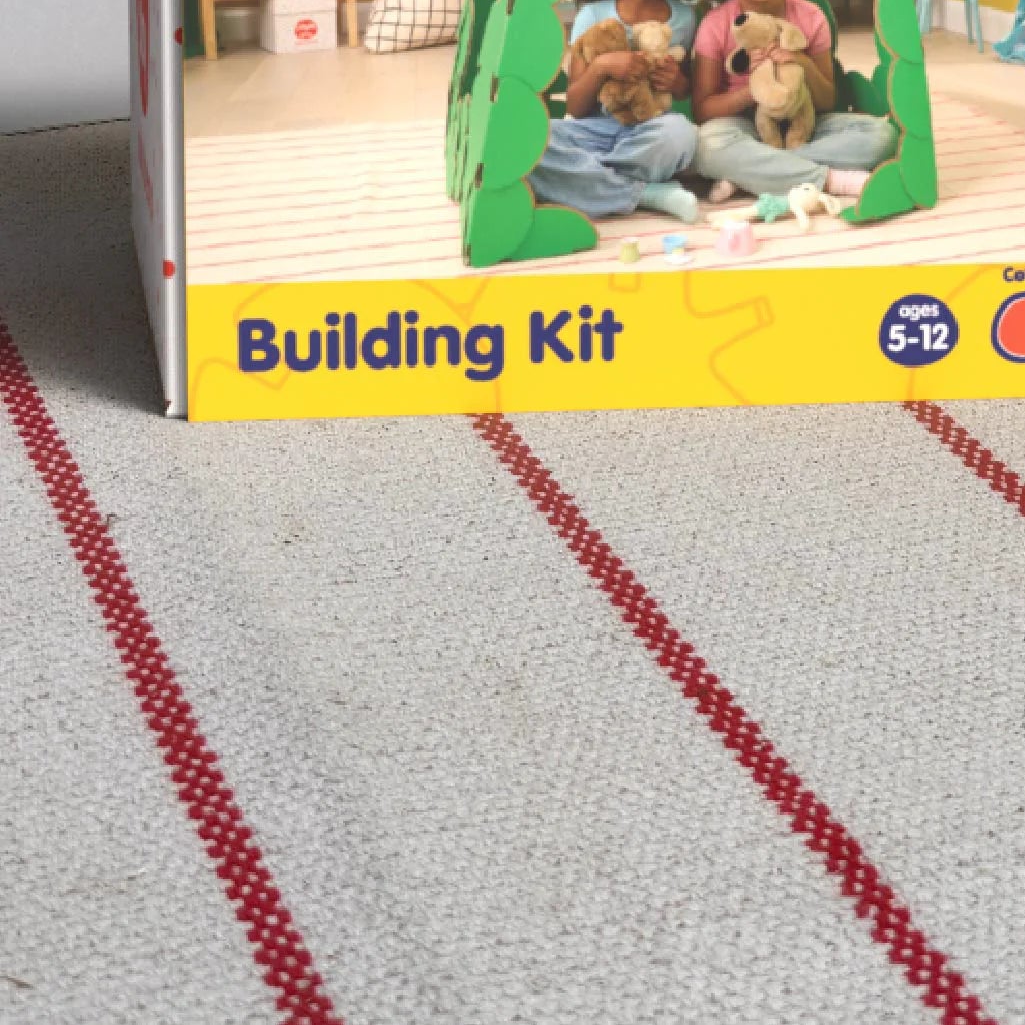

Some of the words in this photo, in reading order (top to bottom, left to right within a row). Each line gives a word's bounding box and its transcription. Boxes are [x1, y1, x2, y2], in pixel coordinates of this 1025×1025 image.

[899, 303, 940, 322] ages
[237, 310, 505, 382] Building
[529, 305, 624, 363] Kit
[887, 323, 950, 352] 5-12
